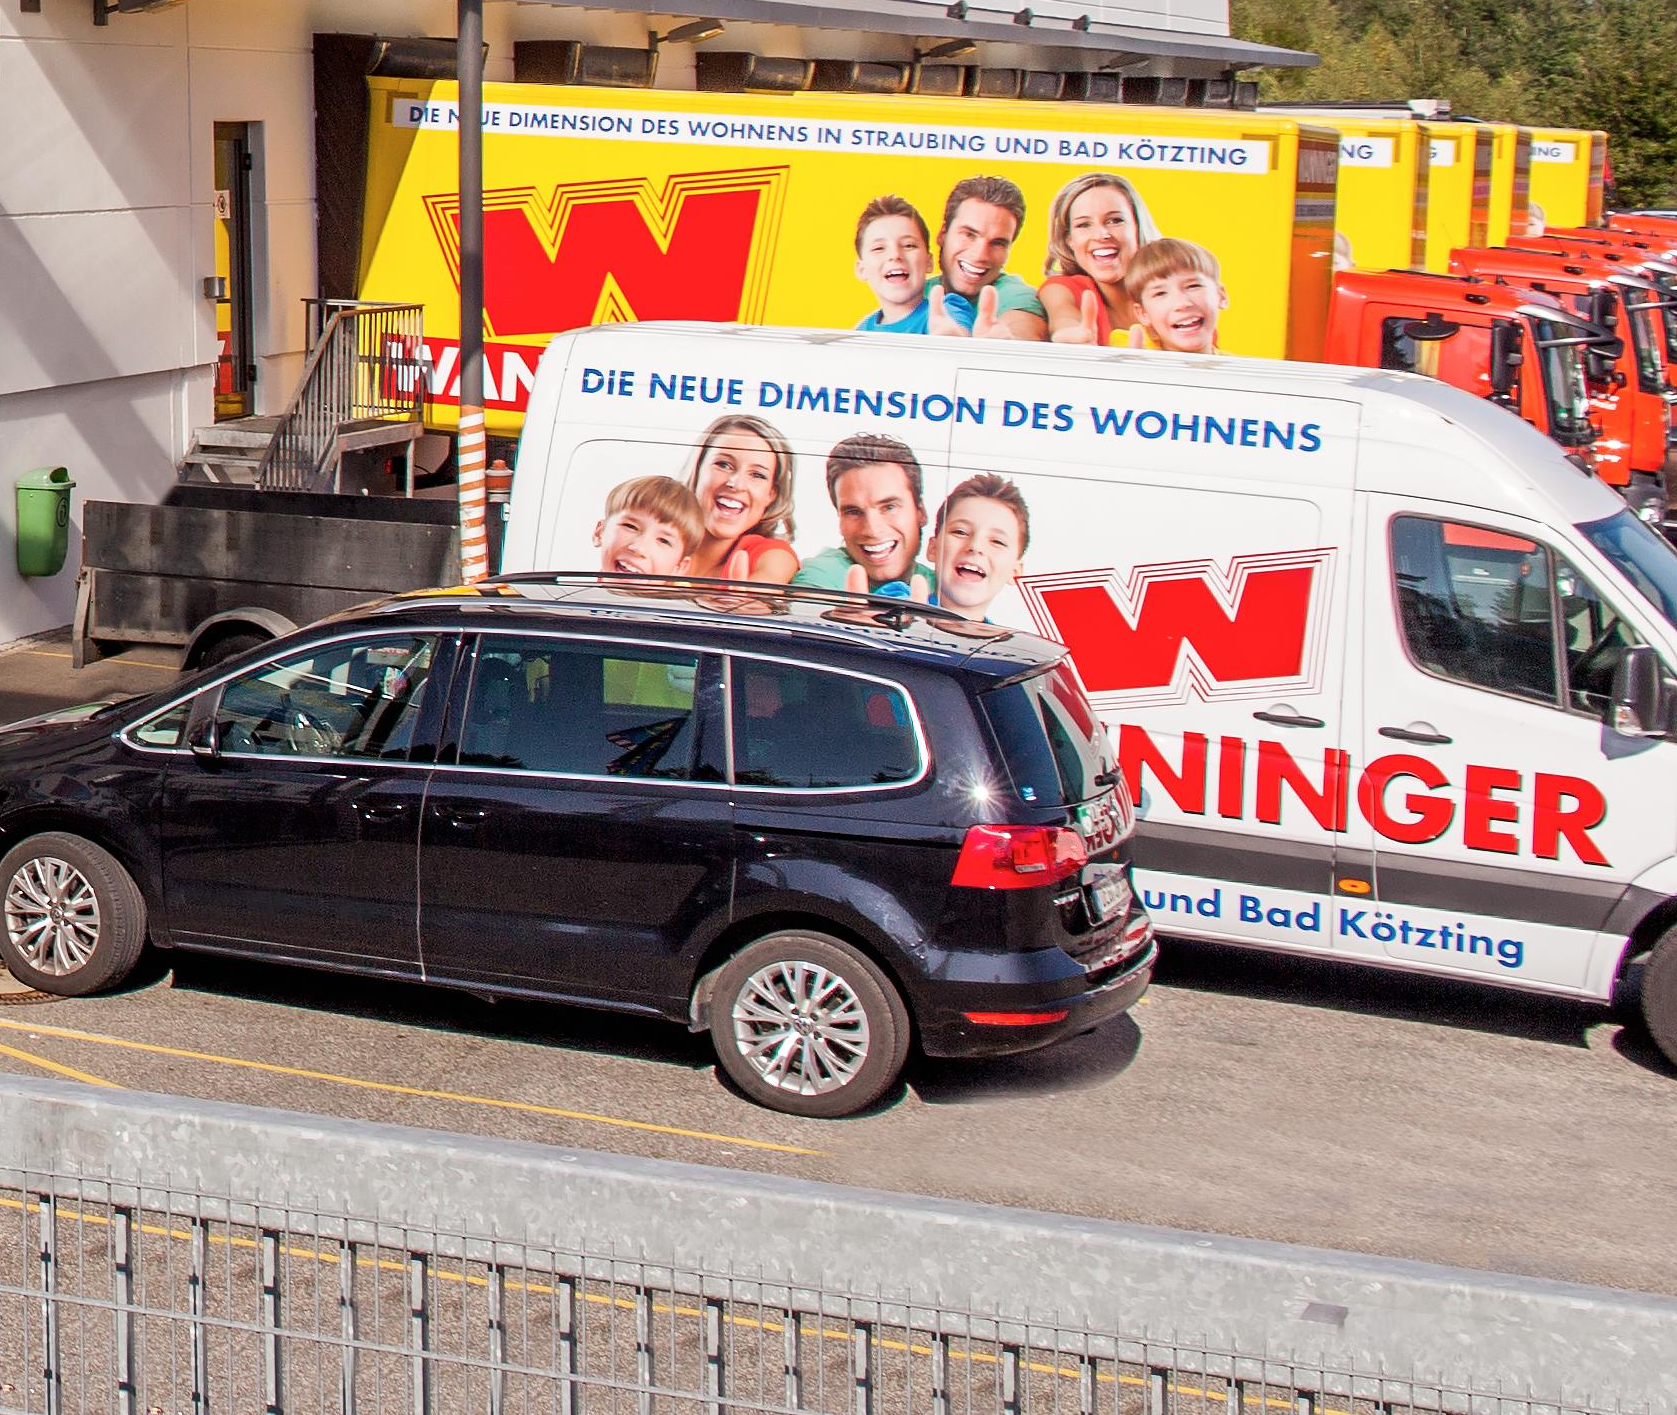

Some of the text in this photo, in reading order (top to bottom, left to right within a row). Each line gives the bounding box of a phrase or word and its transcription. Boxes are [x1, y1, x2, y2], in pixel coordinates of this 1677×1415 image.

[409, 106, 1247, 165] DIE NUE DIMENSION DES WOHNENS IN STRAUBING UND BAD KÖTZTING
[581, 368, 1321, 452] DIE NEUE DIMENSION DES WOHNENS
[1015, 547, 1338, 711] W
[1144, 888, 1221, 918] und
[1239, 894, 1321, 933] Bad
[1339, 908, 1524, 969] Kötzting
